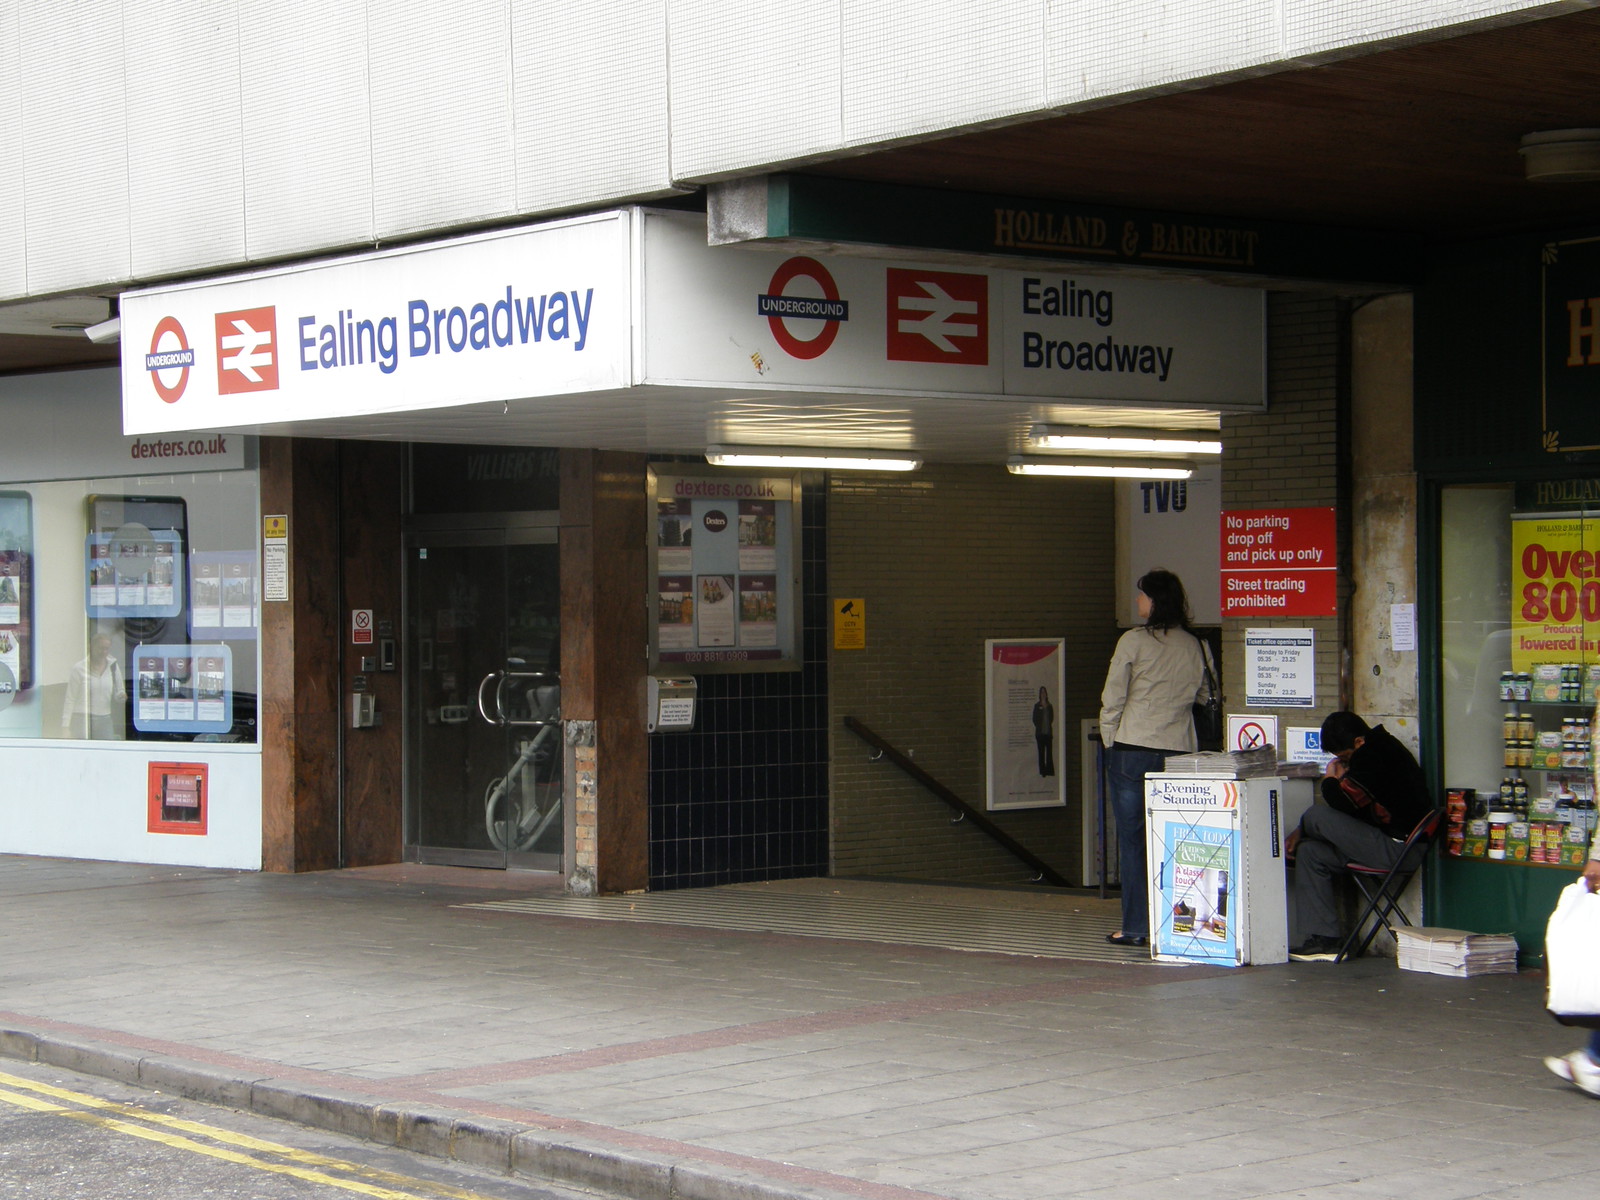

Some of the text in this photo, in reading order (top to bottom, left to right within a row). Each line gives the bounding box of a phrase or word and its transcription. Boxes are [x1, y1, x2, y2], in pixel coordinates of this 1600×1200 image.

[994, 208, 1259, 266] HOLLAND & BARRETT
[761, 298, 844, 317] UNDERGROUND
[1022, 277, 1114, 325] Ealing
[297, 286, 594, 374] Ealing Broadway
[147, 351, 193, 368] UNDERGROUND
[1022, 332, 1174, 381] Broadway
[131, 434, 227, 459] dexters.co.uk
[467, 451, 536, 480] VILLIERS
[675, 479, 775, 497] dexters.co.uk
[1140, 480, 1187, 513] TVU
[706, 516, 726, 525] Dexters
[1227, 515, 1290, 531] No parking
[1536, 524, 1561, 532] HOLLAND
[1227, 531, 1273, 547] drop off
[1227, 547, 1323, 563] and pick up only
[1227, 577, 1306, 593] Street trading
[1227, 594, 1286, 610] prohibited
[1521, 581, 1600, 622] 800
[1544, 624, 1583, 634] Products
[1520, 636, 1576, 651] lowered
[1579, 637, 1594, 650] in
[685, 651, 701, 662] 020
[727, 651, 748, 661] 0909
[1163, 782, 1211, 795] Evening
[1163, 793, 1217, 805] Standard
[1173, 827, 1231, 844] FREE TODAY
[1178, 842, 1206, 854] Homes
[1181, 847, 1192, 862] &
[1192, 853, 1227, 868] Property
[1175, 876, 1195, 885] touch
[1183, 867, 1204, 879] classy
